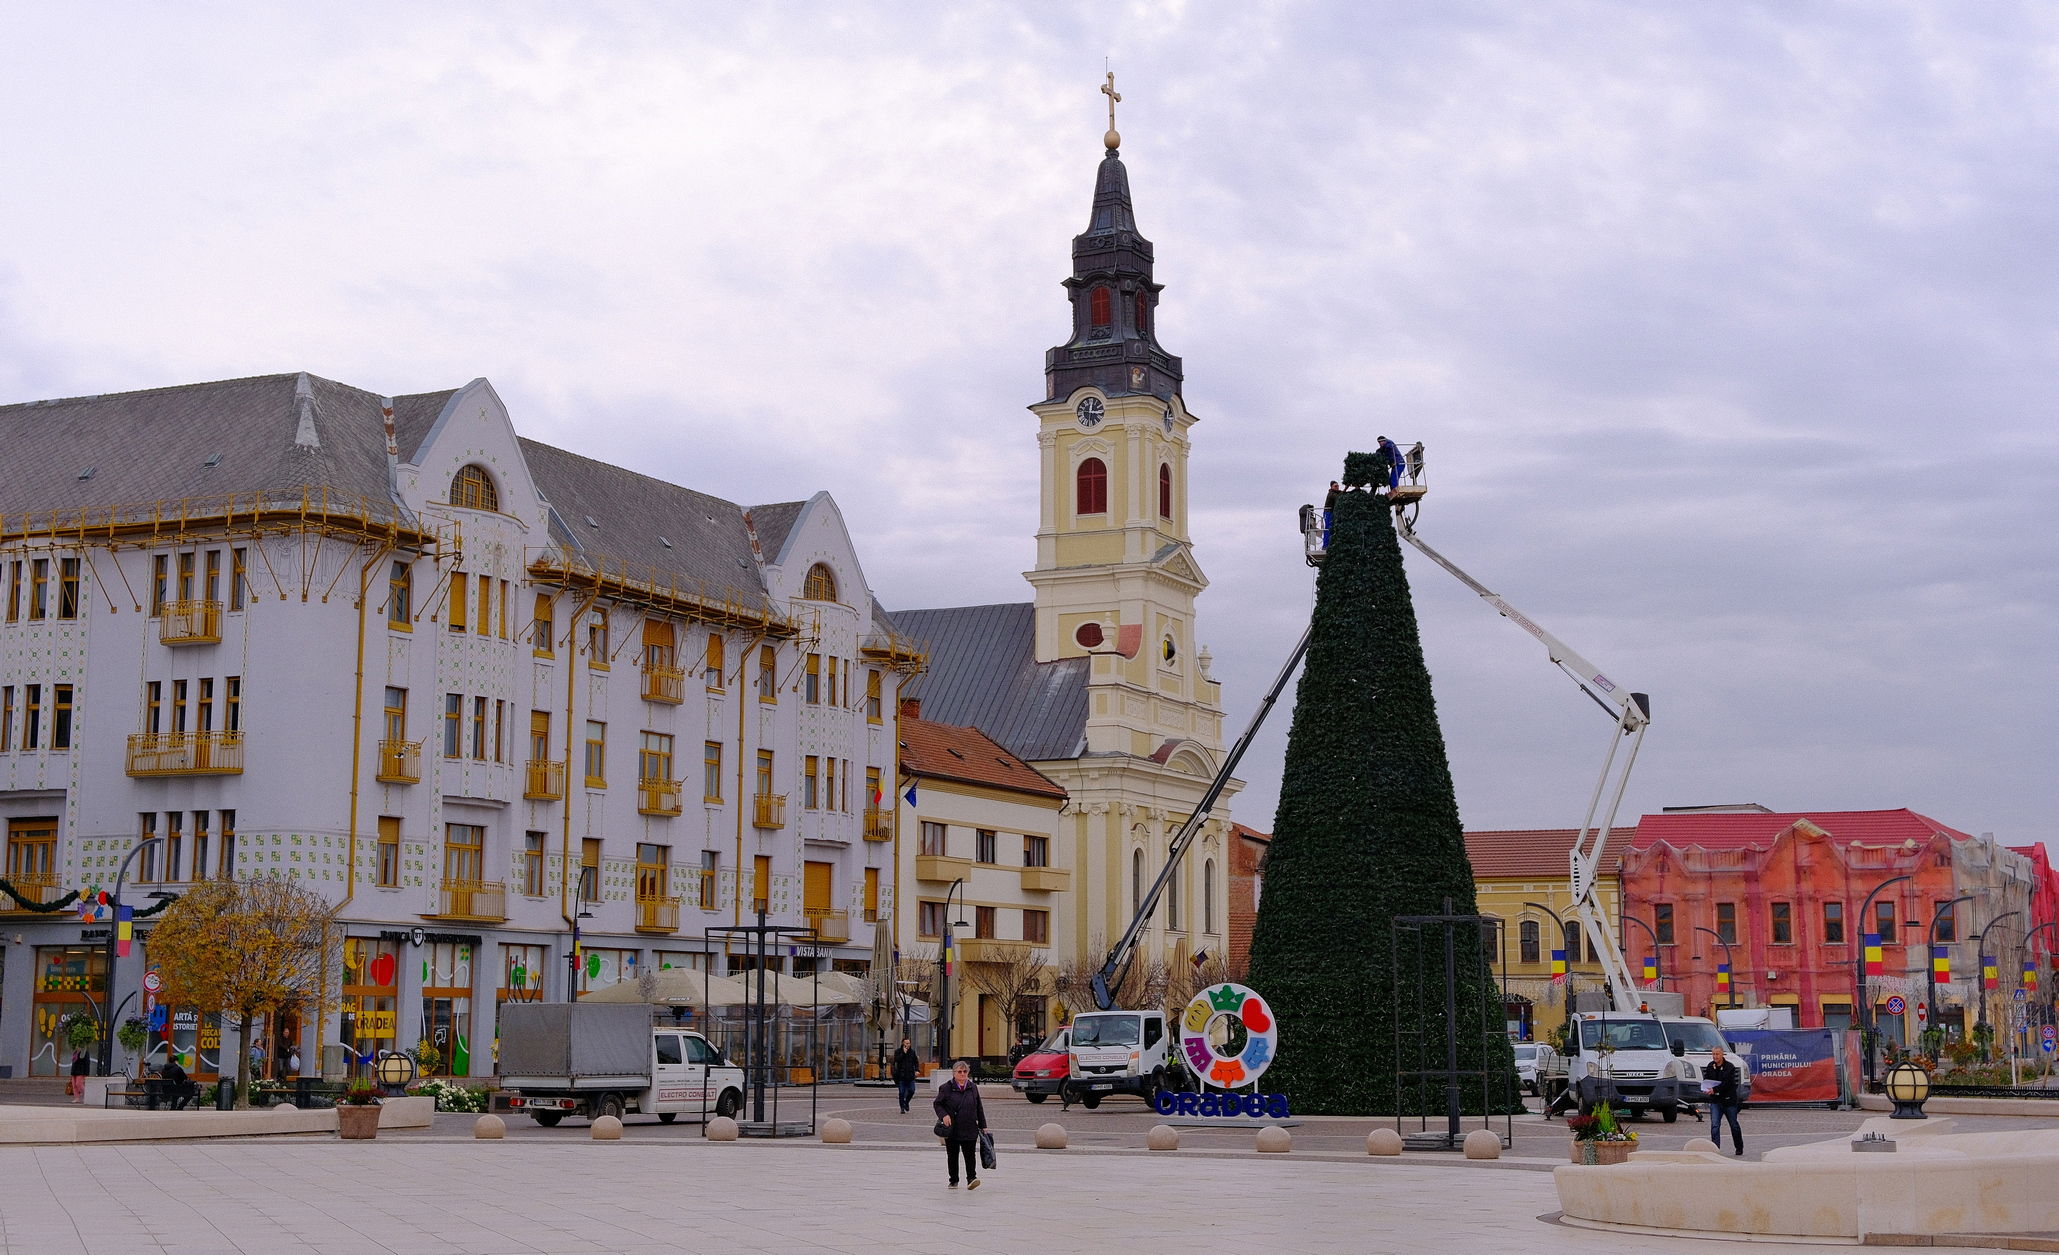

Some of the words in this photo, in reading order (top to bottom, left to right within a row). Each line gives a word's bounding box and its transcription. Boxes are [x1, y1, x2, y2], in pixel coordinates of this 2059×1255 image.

[1496, 600, 1519, 619] ELECTRO
[797, 946, 815, 957] VISTA
[816, 947, 833, 958] BANK
[341, 1002, 356, 1012] RAG
[356, 1017, 396, 1030] ORADEA
[200, 1036, 220, 1049] COL
